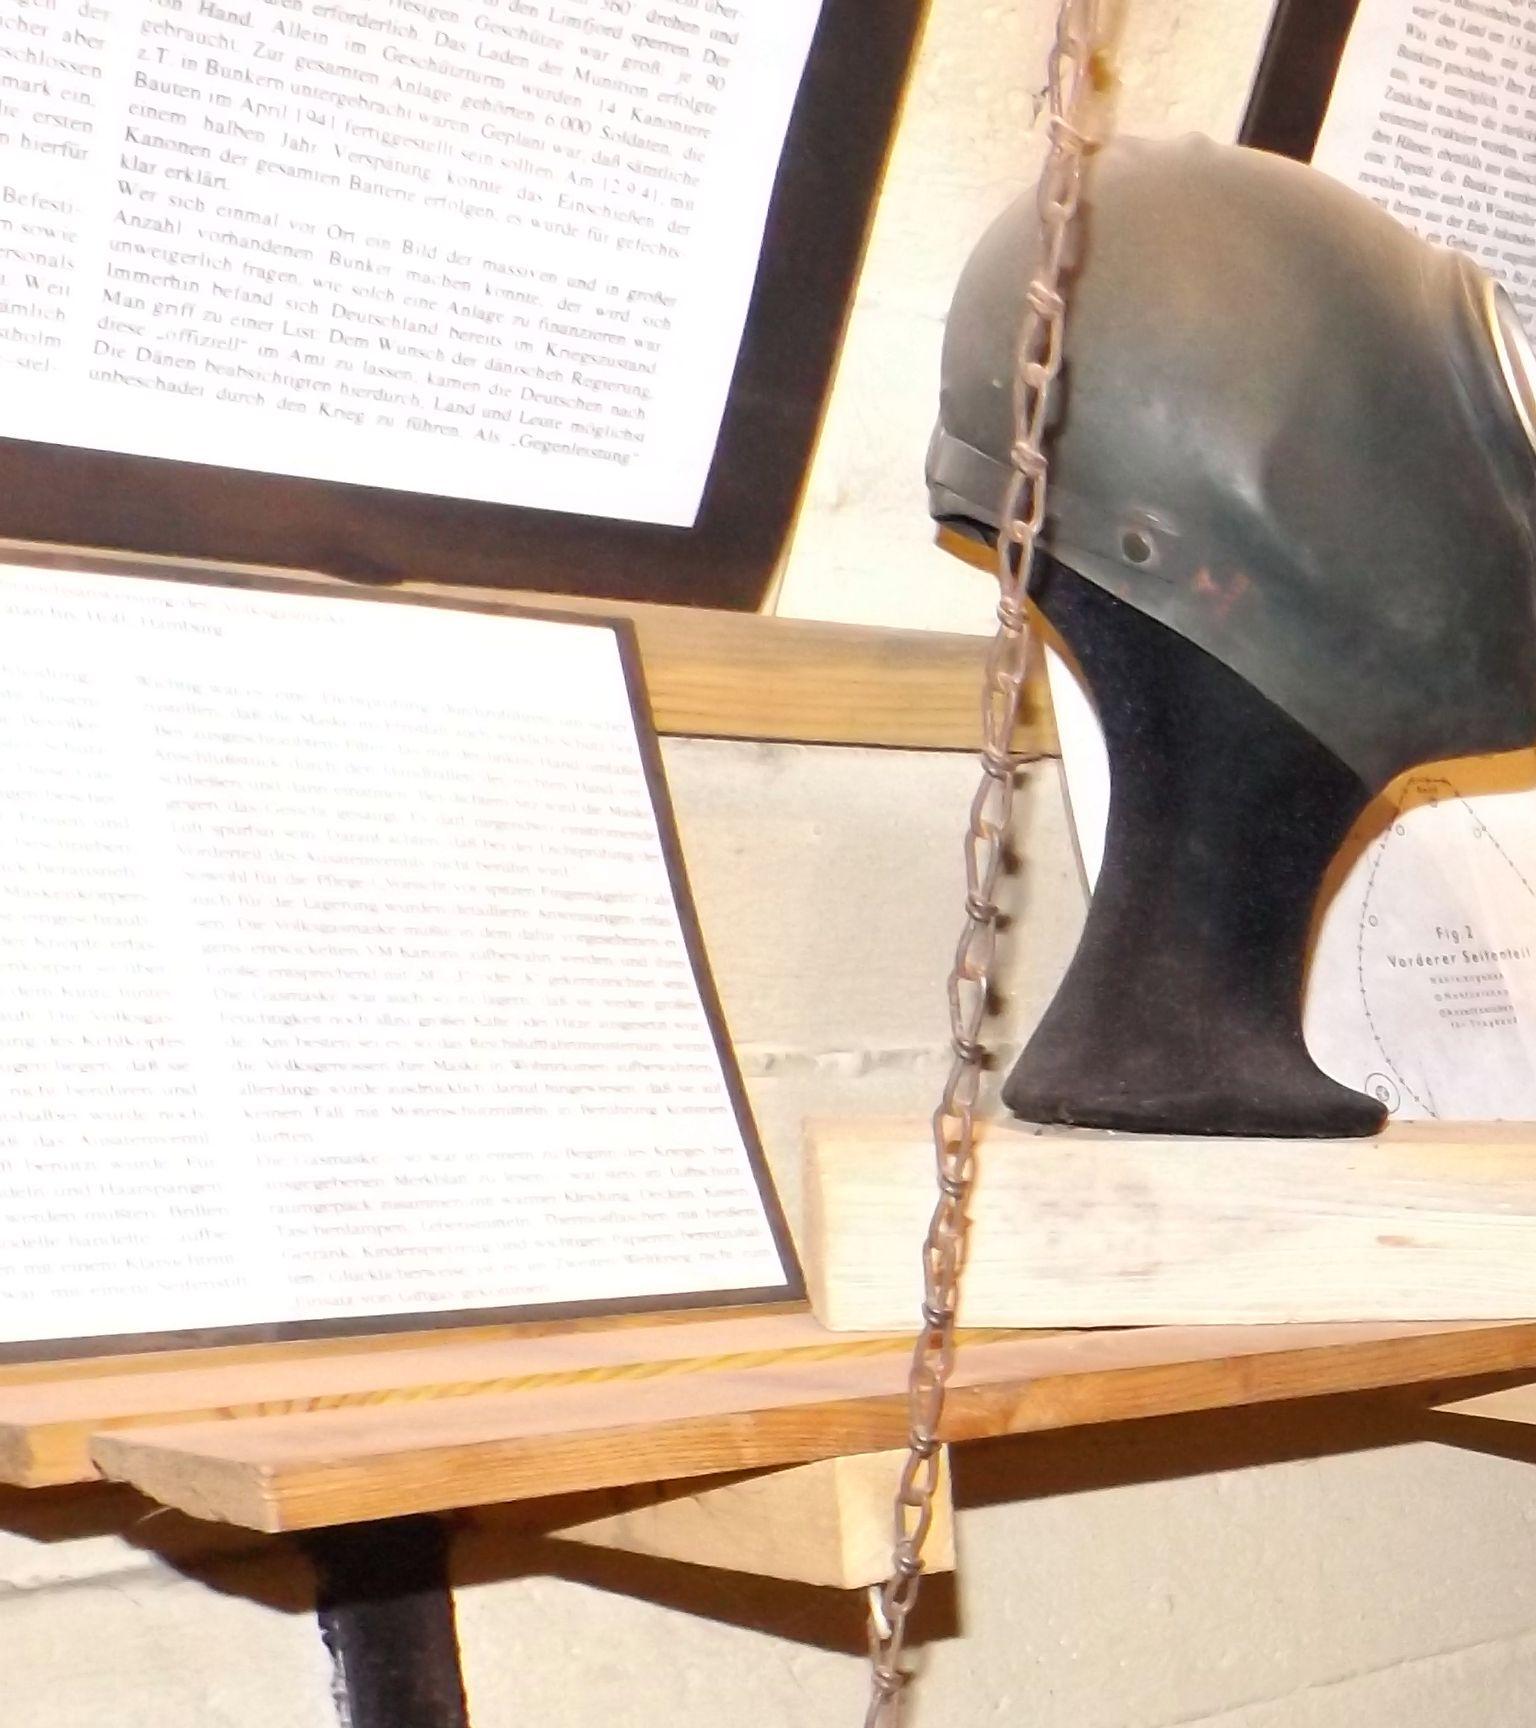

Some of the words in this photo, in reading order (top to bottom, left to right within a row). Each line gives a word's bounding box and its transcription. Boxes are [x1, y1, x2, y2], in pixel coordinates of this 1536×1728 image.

[273, 18, 328, 45] Allein
[599, 98, 616, 114] 14
[433, 29, 466, 51] Das
[477, 41, 529, 66] Laden
[574, 65, 648, 97] Munition
[473, 14, 564, 49] Geschütze
[579, 45, 609, 61] war
[507, 0, 538, 17] den
[547, 6, 623, 40] Limfjord
[701, 47, 730, 66] Der
[644, 8, 700, 33] drehen
[708, 29, 739, 45] und
[133, 69, 201, 100] Bauten
[208, 92, 232, 106] im
[241, 96, 287, 118] April
[180, 56, 198, 70] in
[204, 57, 284, 90] Bunkern
[290, 82, 411, 119] untergebracht
[480, 122, 545, 149] Geplant
[590, 149, 620, 167] daß
[252, 40, 284, 62] Zur
[294, 55, 379, 84] gesamten
[392, 75, 452, 102] Anlage
[460, 96, 535, 119] gehörten
[119, 152, 157, 174] klar
[123, 124, 211, 158] Kanonen
[255, 158, 340, 185] gesamten
[348, 173, 414, 201] Batterie
[127, 102, 186, 124] einem
[203, 114, 265, 142] halben
[280, 131, 316, 153] Jahr
[114, 208, 181, 234] Anzahl
[197, 228, 313, 259] vorhandenen
[328, 249, 391, 272] Bunker
[406, 270, 471, 291] machen
[117, 178, 156, 201] Wer
[215, 205, 279, 226] einmal
[326, 223, 355, 243] Ort
[401, 238, 437, 259] Bild
[566, 277, 597, 291] und
[106, 261, 199, 292] Immerhin
[211, 280, 273, 306] befand
[330, 301, 438, 335] Deutschland
[448, 325, 502, 346] bereits
[109, 239, 232, 270] unweigerlich
[351, 285, 394, 301] solch
[447, 300, 503, 324] Anlage
[96, 314, 144, 336] diese
[257, 345, 279, 358] im
[289, 348, 325, 365] Amt
[426, 371, 480, 390] kamen
[519, 385, 602, 411] Deutschen
[102, 287, 145, 310] Man
[151, 301, 194, 318] griff
[201, 309, 222, 323] zu
[229, 316, 274, 331] einer
[328, 327, 369, 348] Dem
[378, 336, 445, 361] Wunsch
[483, 357, 563, 382] dänischen
[88, 368, 204, 396] unbeschadet
[215, 387, 265, 406] durch
[276, 396, 306, 413] den
[475, 427, 499, 441] Als
[92, 338, 126, 359] Die
[135, 345, 196, 368] Dänen
[433, 395, 476, 416] Land
[481, 408, 512, 422] und
